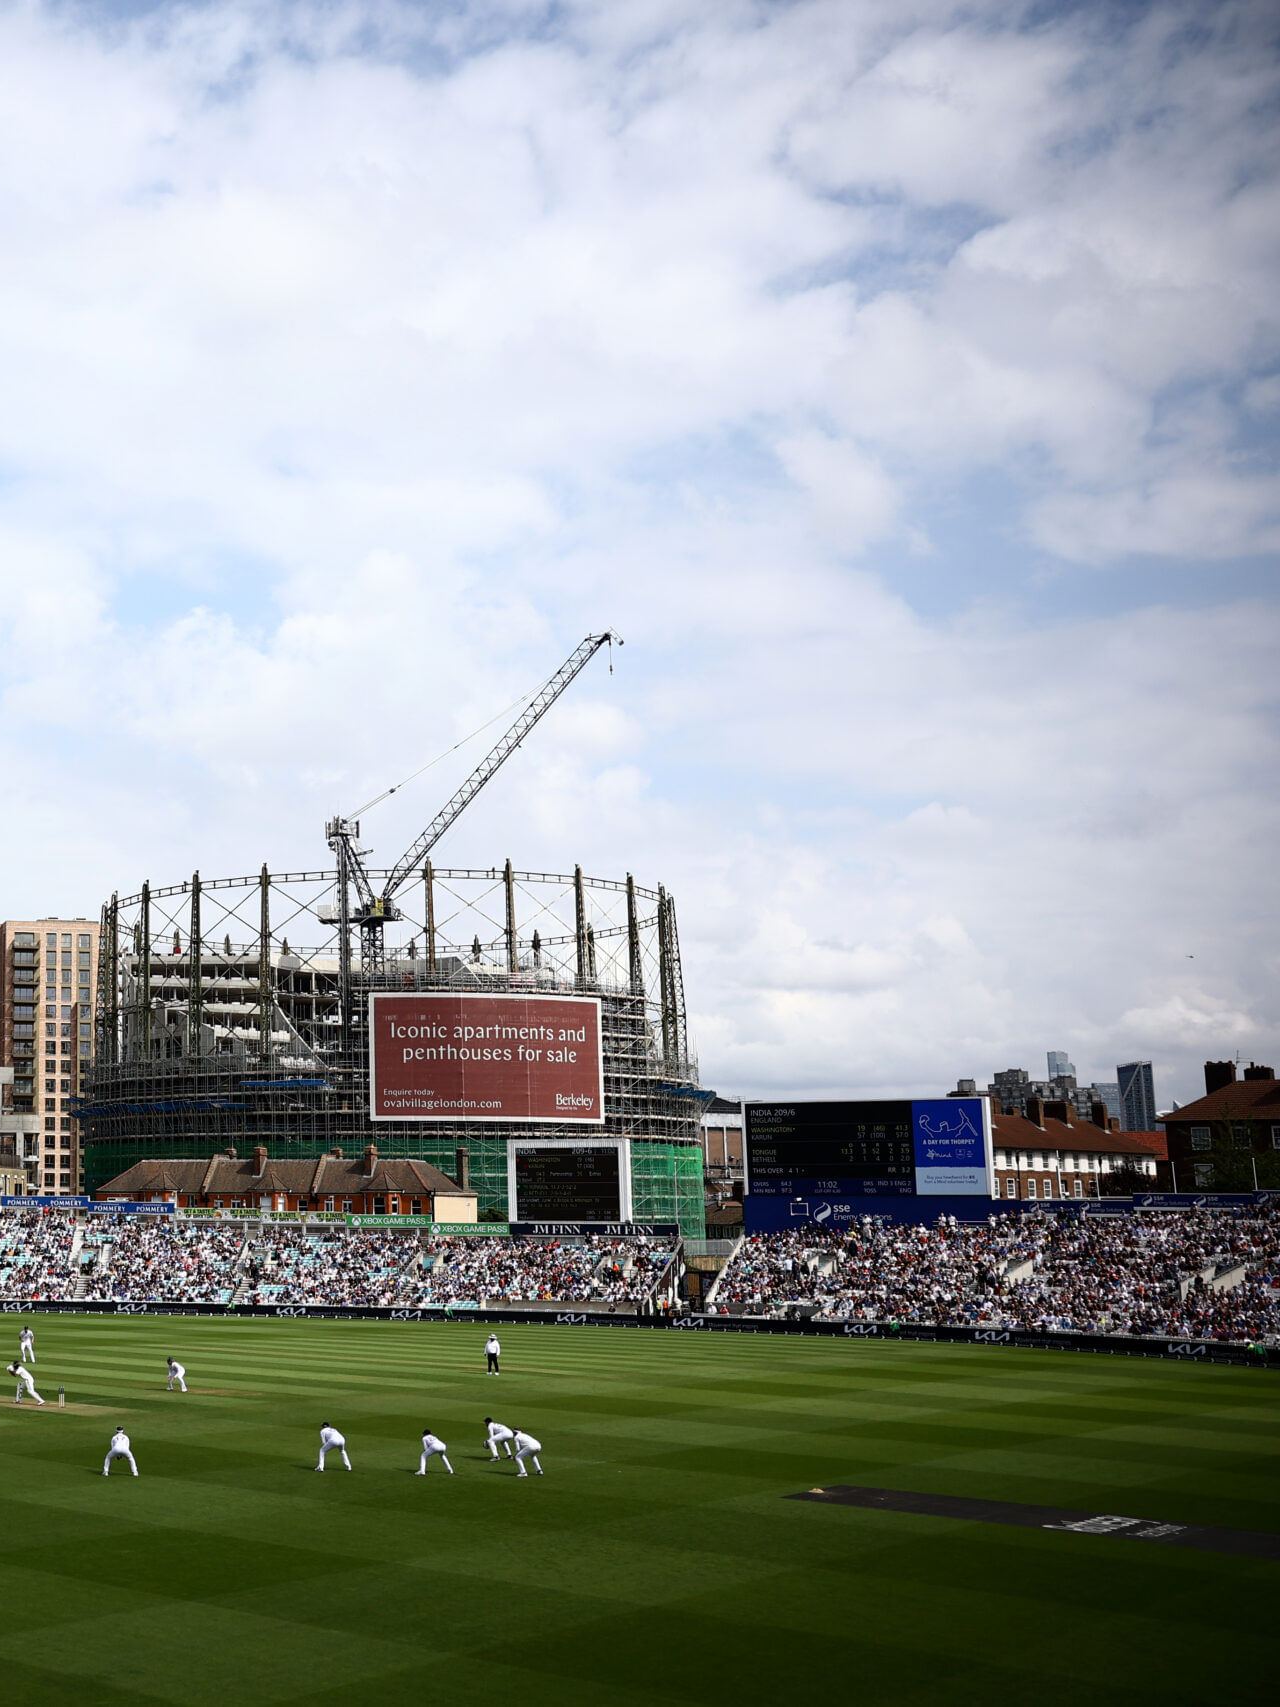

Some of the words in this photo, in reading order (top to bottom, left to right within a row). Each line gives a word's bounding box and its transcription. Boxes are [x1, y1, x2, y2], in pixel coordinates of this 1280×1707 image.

[390, 1022, 448, 1039] Iconic
[453, 1024, 554, 1042] apartments
[558, 1026, 586, 1042] and
[403, 1044, 512, 1063] penthouses
[517, 1045, 543, 1061] for
[546, 1047, 577, 1063] sale
[383, 1088, 413, 1097] Enquire
[414, 1088, 435, 1097] today
[383, 1098, 502, 1110] ovalvillagelondon.com
[555, 1093, 594, 1111] Berkeley
[750, 1109, 771, 1117] INDIA
[774, 1109, 796, 1117] 209/6
[817, 1181, 838, 1189] 11:02
[136, 1205, 169, 1213] POMMERY
[833, 1204, 851, 1213] sse
[362, 1216, 381, 1225] XBOX
[382, 1216, 403, 1225] GAME
[404, 1216, 426, 1225] PASS
[833, 1213, 858, 1222] Energy
[442, 1224, 463, 1233] XBOX
[463, 1224, 485, 1233] GAME
[487, 1224, 508, 1233] PASS
[532, 1225, 549, 1234] JM
[552, 1225, 581, 1234] FINN
[604, 1225, 621, 1235] JM
[624, 1225, 654, 1235] FINN
